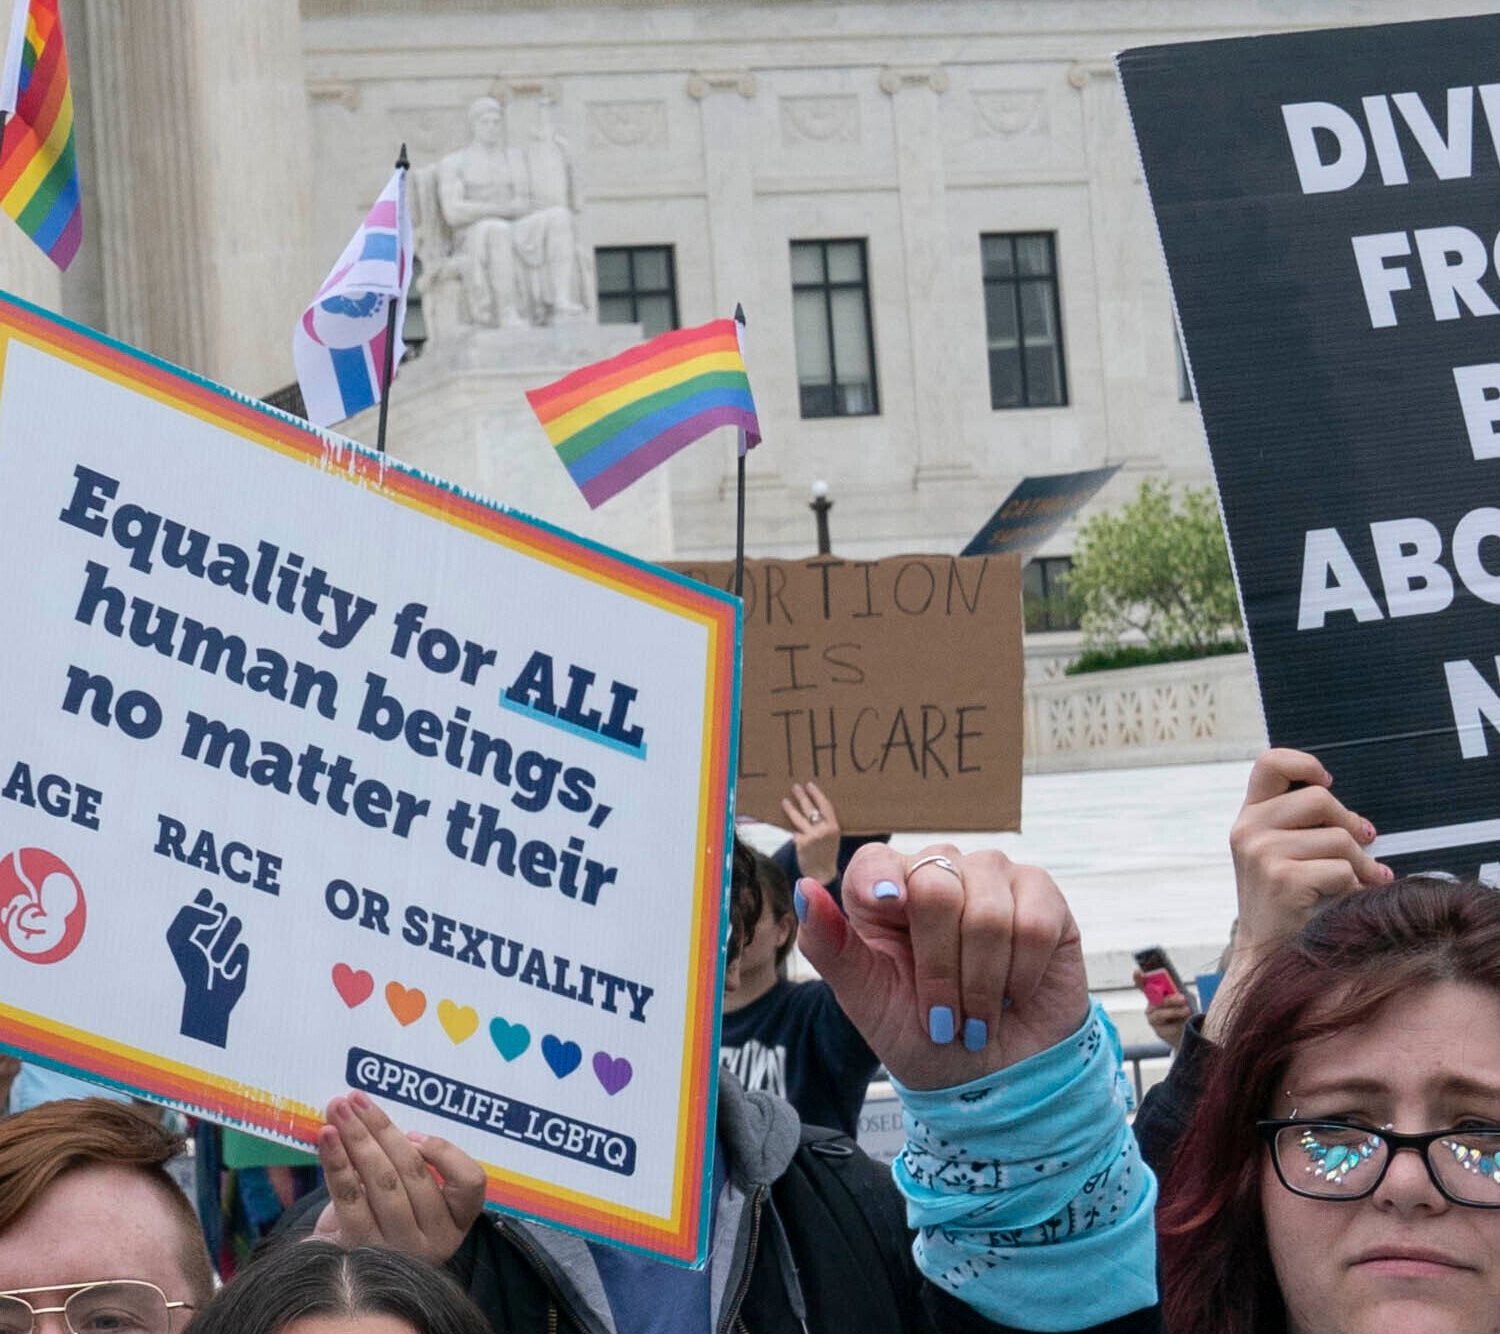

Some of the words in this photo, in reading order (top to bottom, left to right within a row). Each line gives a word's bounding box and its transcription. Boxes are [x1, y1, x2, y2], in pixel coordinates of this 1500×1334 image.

[59, 463, 377, 649] Equality
[391, 603, 497, 685] for
[504, 651, 645, 749] ALL
[688, 557, 988, 625] ORTION
[770, 642, 865, 694] IS
[74, 561, 338, 720] human
[358, 672, 615, 828] beings,
[738, 705, 987, 780] LTHCARE
[62, 665, 163, 740] no
[181, 710, 431, 838] matter
[446, 800, 618, 907] their
[1, 761, 103, 831] AGE
[154, 814, 283, 896] RACE
[325, 879, 390, 936] OR
[402, 905, 655, 1024] SEXUALITY
[356, 1054, 628, 1166] @PROLIFE_LGBTQ
